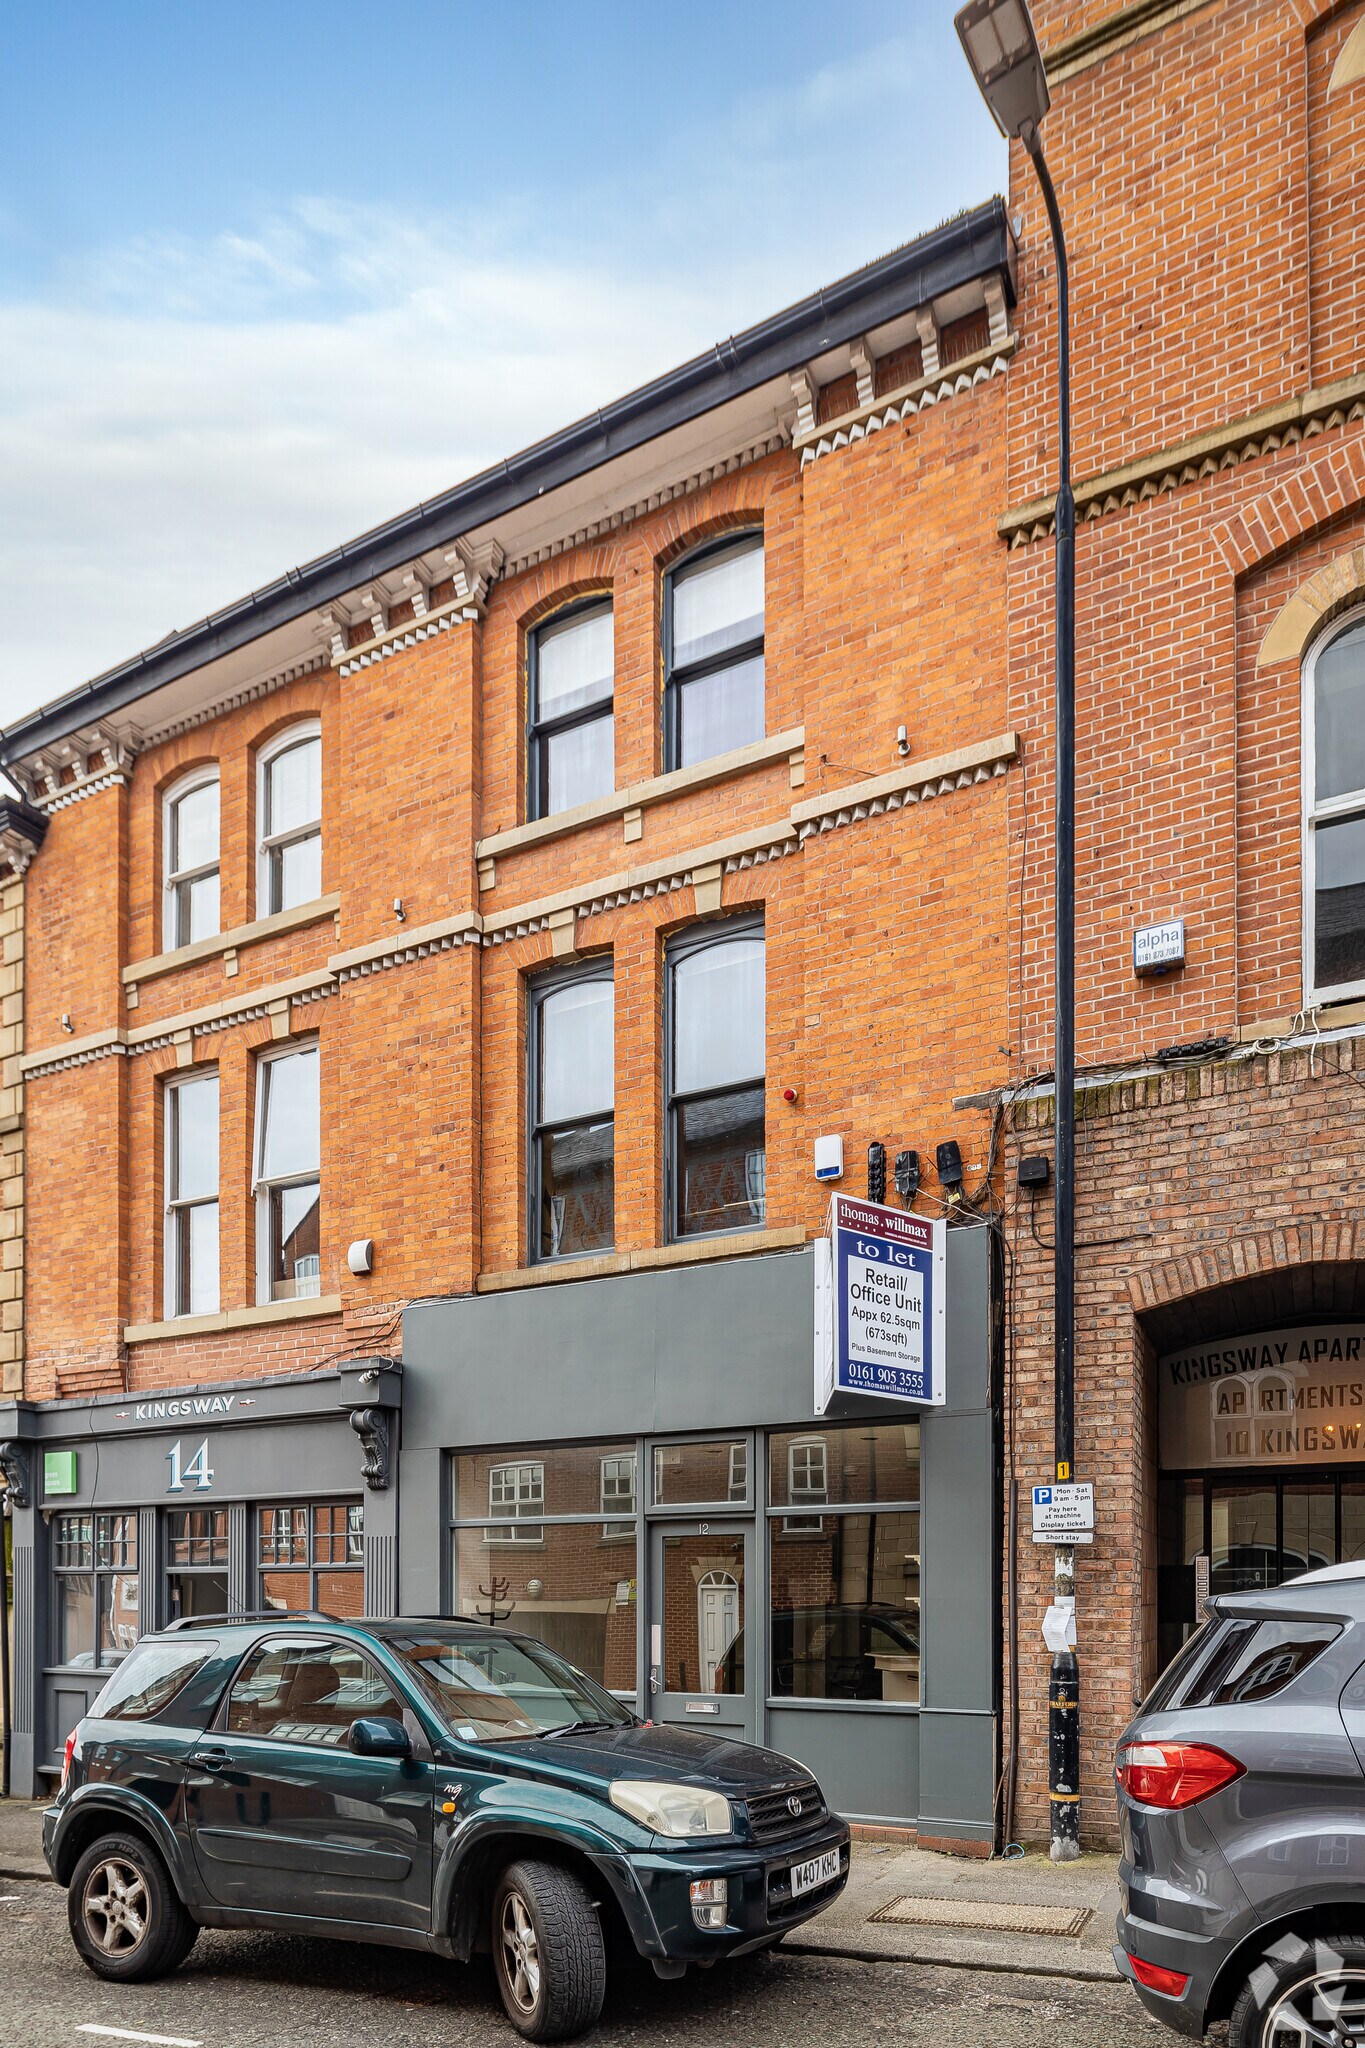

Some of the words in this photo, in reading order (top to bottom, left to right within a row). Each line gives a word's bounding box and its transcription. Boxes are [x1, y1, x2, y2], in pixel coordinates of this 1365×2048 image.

[1138, 929, 1179, 950] alpha
[857, 1240, 879, 1258] to
[887, 1245, 916, 1267] let
[866, 1267, 908, 1292] Retail/
[851, 1283, 891, 1306] Office
[895, 1293, 922, 1313] Unit
[851, 1305, 878, 1322] Appx
[880, 1311, 920, 1331] 62.5sqm
[865, 1326, 908, 1347] (673sqft)
[851, 1342, 866, 1352] Plus
[866, 1346, 897, 1358] Basement
[898, 1351, 921, 1364] Storage
[1170, 1342, 1288, 1385] KINGSWAY
[1298, 1337, 1365, 1363] APAR
[848, 1379, 924, 1396] www.thomaswillmax.co.uk
[849, 1363, 874, 1380] 0161
[878, 1368, 897, 1384] 905
[899, 1372, 924, 1389] 3555
[135, 1395, 235, 1420] KINGSWAY
[1218, 1383, 1362, 1415] APARTMENTS
[1226, 1430, 1248, 1455] 10
[1261, 1425, 1365, 1454] KINGSW
[165, 1437, 215, 1493] 14
[1060, 1463, 1065, 1477] 1
[1038, 1489, 1050, 1504] P
[699, 1523, 709, 1535] 12
[795, 1858, 820, 1890] W407
[821, 1851, 837, 1878] KHC
